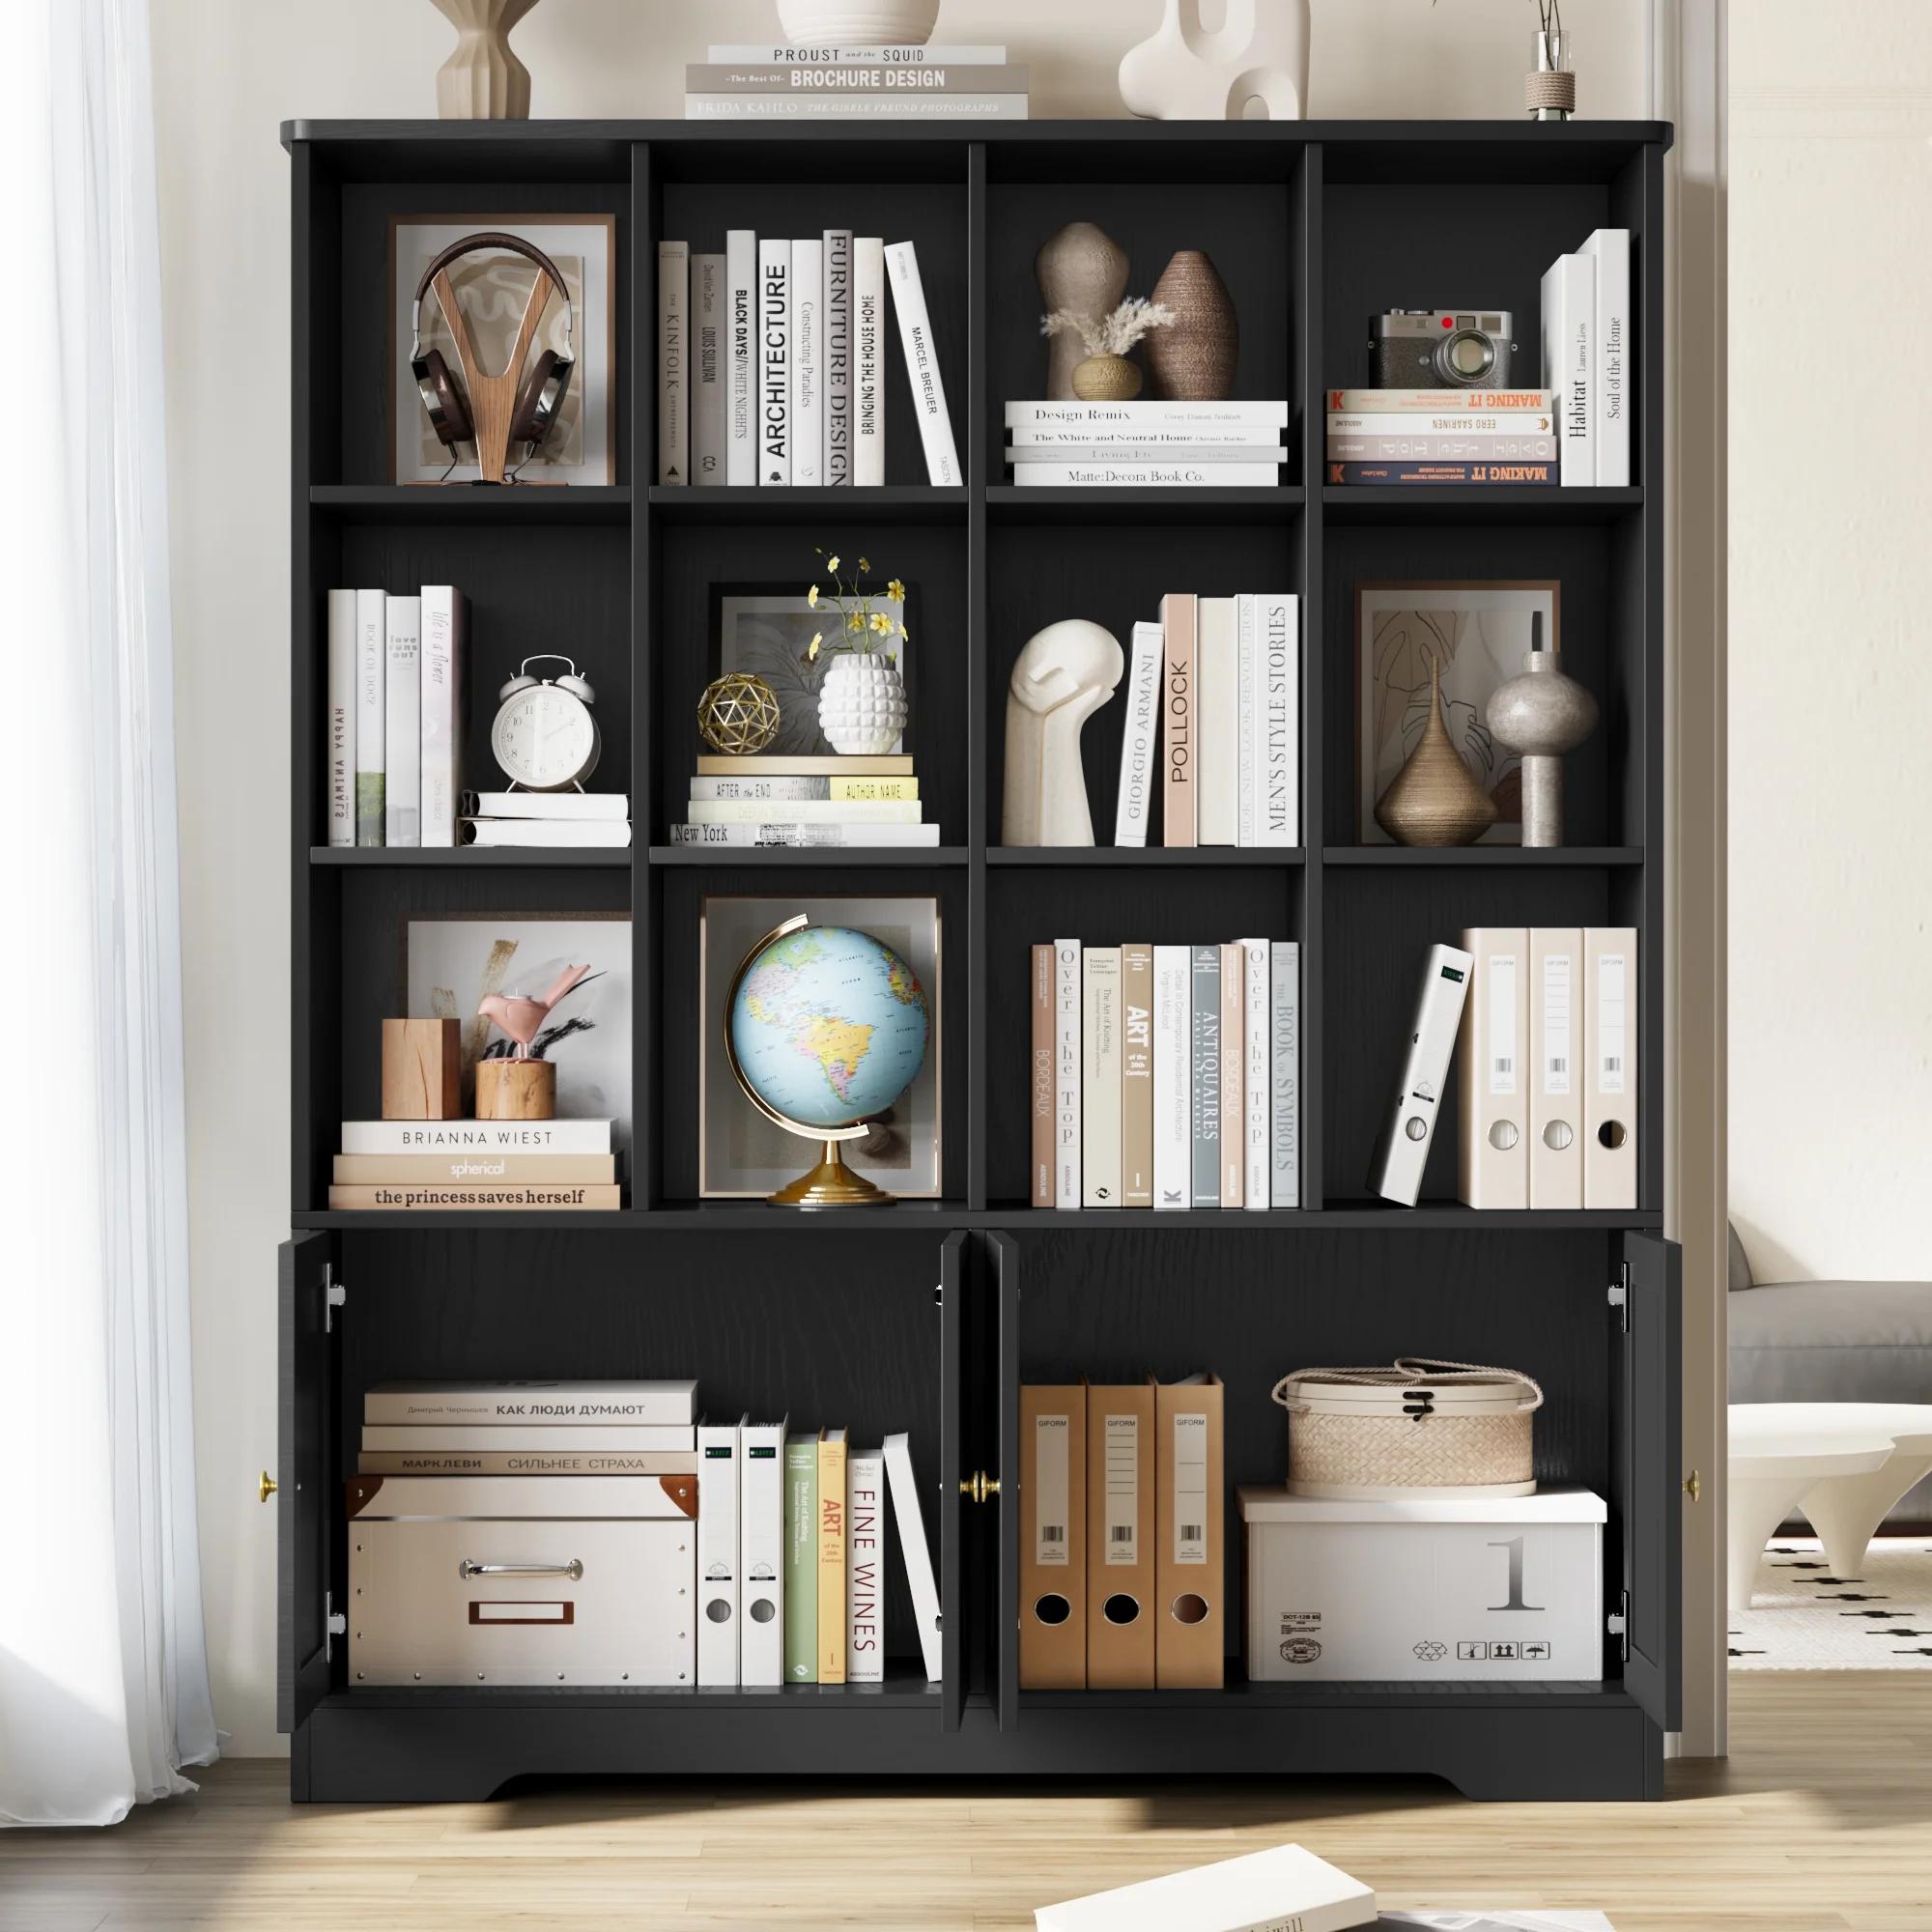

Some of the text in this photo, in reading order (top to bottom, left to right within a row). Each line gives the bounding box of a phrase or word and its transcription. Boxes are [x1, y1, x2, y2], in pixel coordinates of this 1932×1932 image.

[774, 49, 840, 62] PROUST
[883, 49, 924, 62] SQUID
[749, 73, 768, 83] Best
[790, 70, 881, 87] BROCHURE
[885, 70, 946, 87] DESIGN
[696, 102, 741, 114] FRIDA
[746, 102, 798, 114] KAHLO
[921, 103, 1000, 112] PHOTOGRAPHS
[734, 289, 748, 325] BLACK
[701, 327, 716, 349] LOUIS
[798, 301, 813, 367] Constructing
[666, 315, 680, 390] KINFOLK
[701, 349, 716, 384] SULLIVAN
[766, 264, 785, 459] ARCHITECTURE
[830, 234, 847, 486] FURNITURE DESIGN
[861, 295, 875, 435] BRINGING THE HOUSE HOME
[1576, 345, 1586, 372] Lauren
[1606, 317, 1621, 419] Soul of the Home
[911, 326, 938, 415] MARCEL BREUER
[1035, 409, 1132, 423] Design Remix
[1468, 394, 1484, 407] IT
[1486, 394, 1543, 407] MAKING
[1569, 380, 1586, 439] Habitat
[1432, 419, 1473, 429] SAARINEN
[702, 456, 716, 472] CCA
[1151, 469, 1182, 482] Book
[1185, 470, 1206, 482] Co.
[1471, 467, 1548, 480] MAKING IT
[389, 635, 417, 643] love
[1171, 660, 1189, 783] POLLOCK
[1268, 605, 1287, 833] MEN'S STYLE STORIES
[506, 732, 514, 743] 9
[510, 749, 518, 758] 8
[1128, 654, 1155, 820] GIORGIO ARMANI
[716, 783, 740, 798] AFTER
[743, 789, 753, 798] the
[755, 783, 771, 798] END
[845, 784, 903, 800] AUTHOR NAME
[674, 823, 728, 842] New York
[1061, 949, 1075, 1010] Over
[1250, 949, 1264, 1010] Over
[1127, 1006, 1150, 1047] ART
[1276, 1006, 1294, 1058] BOOK
[1063, 1030, 1073, 1075] the
[1036, 1049, 1051, 1119] BORDEAUX
[1203, 1011, 1218, 1141] ANTIQUAIRES
[1225, 1049, 1239, 1119] BORDEAUX
[402, 1131, 553, 1145] BRIANNA WIEST
[1276, 1077, 1294, 1172] SYMBOLS
[449, 1159, 506, 1179] spherical
[375, 1189, 585, 1208] the princess saves herself
[1163, 1189, 1182, 1203] K
[496, 1405, 527, 1415] КАК
[529, 1405, 576, 1416] ЛЮДИ
[579, 1405, 645, 1416] ДУМАЮТ
[1176, 1418, 1205, 1427] GIFORM
[402, 1458, 645, 1469] МАРК ЛЕВИ СИЛЬНЕЕ СТРАХА
[823, 1498, 841, 1537] ART
[853, 1491, 875, 1549] FINE
[1487, 1536, 1546, 1611] 1
[853, 1562, 875, 1651] WINES
